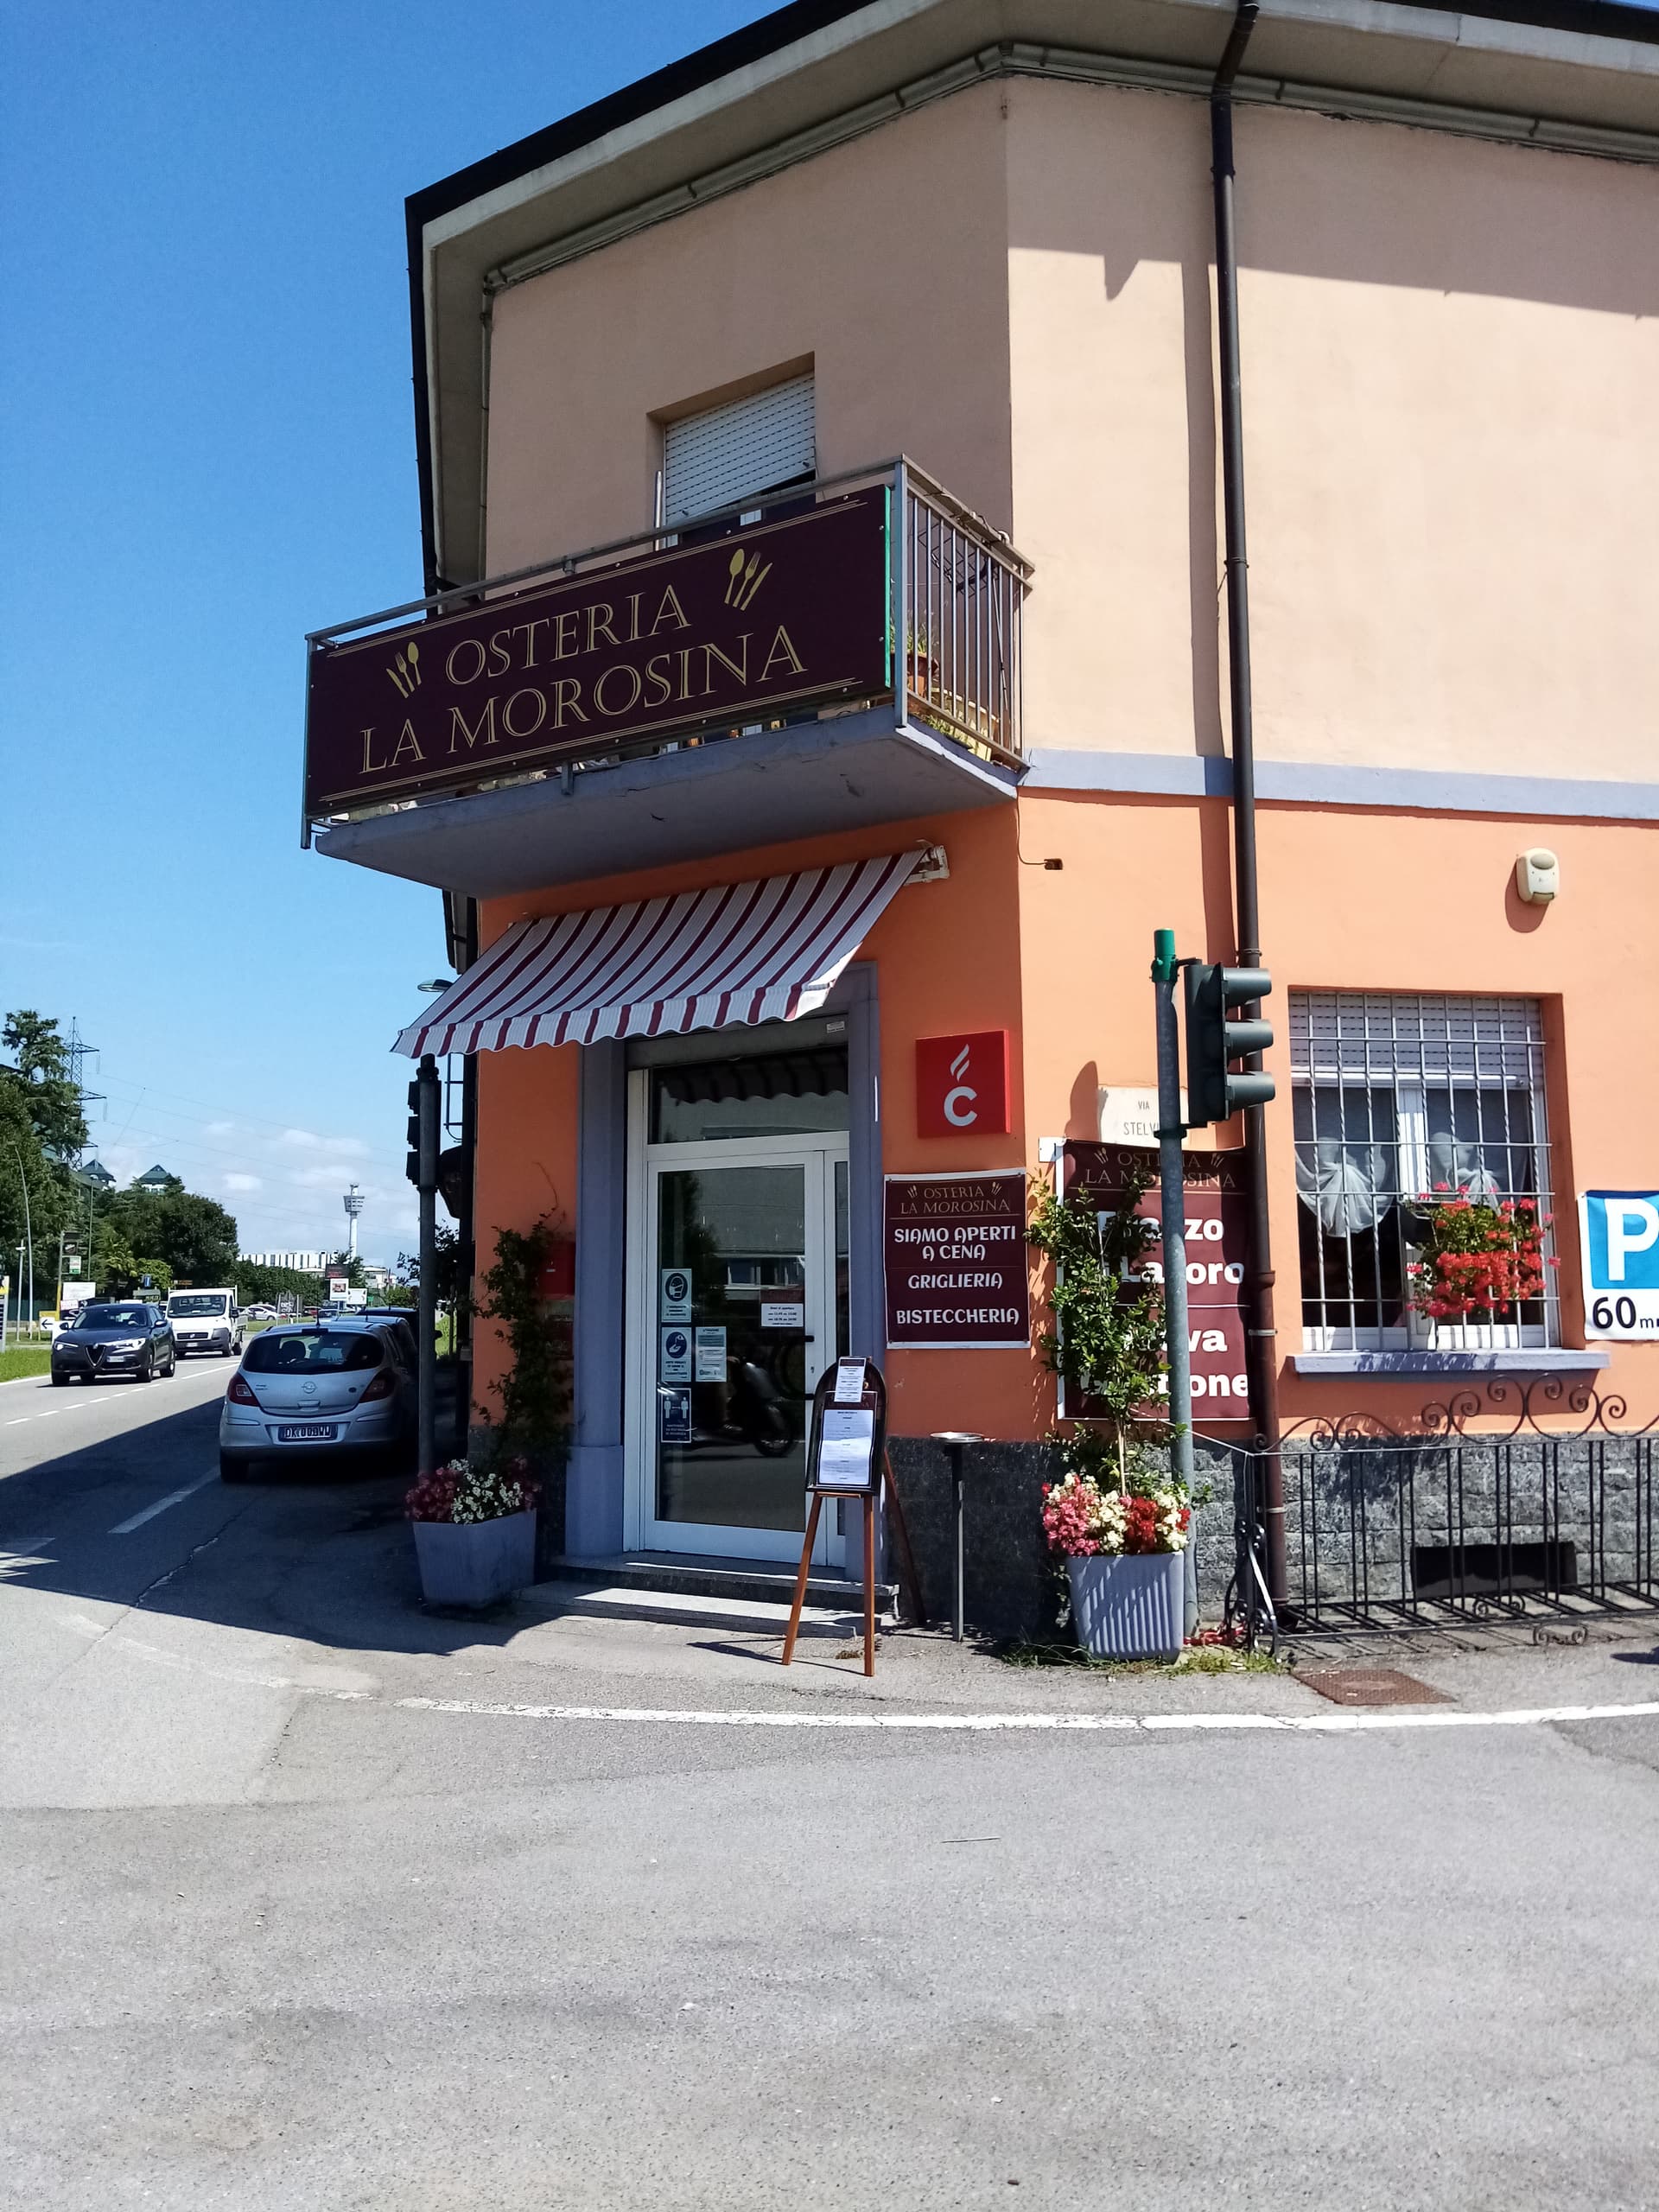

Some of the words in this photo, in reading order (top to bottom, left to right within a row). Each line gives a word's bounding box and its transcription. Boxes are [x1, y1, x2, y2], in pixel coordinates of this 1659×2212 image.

[445, 584, 691, 686] OSTERIA
[359, 718, 427, 774] LA
[447, 625, 808, 754] MOROSINA
[1138, 1101, 1150, 1110] VIA
[1123, 1122, 1160, 1135] STELVI
[1085, 1168, 1112, 1185] LA
[924, 1185, 984, 1199] OSTERIA
[900, 1202, 918, 1215] LA
[923, 1198, 1010, 1213] MOROSINA
[894, 1227, 950, 1245] SIAMO
[954, 1225, 1016, 1244] APERTI
[1604, 1198, 1659, 1281] P
[922, 1245, 935, 1262] A
[939, 1243, 986, 1261] CENA
[1120, 1255, 1244, 1286] Laoro
[908, 1272, 1003, 1290] GRIGLIERIA
[896, 1307, 1020, 1325] BISTECCHERIA
[1592, 1296, 1637, 1330] 60
